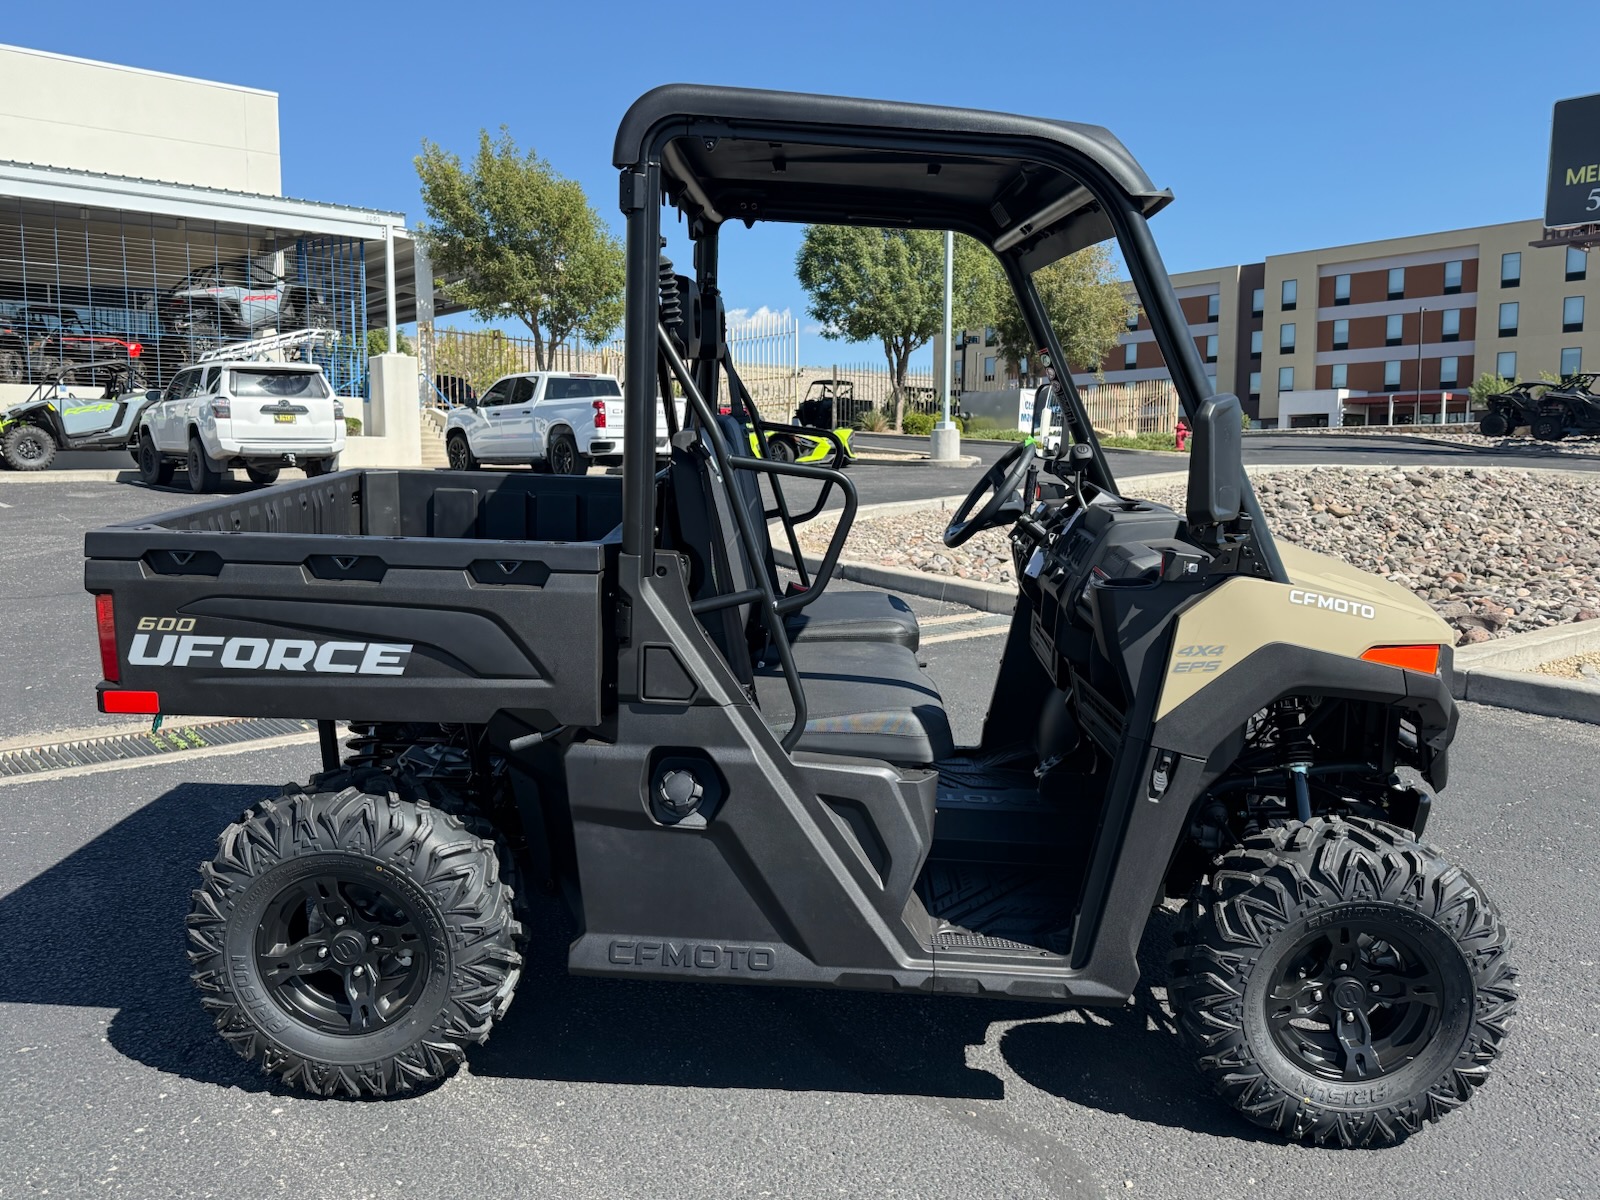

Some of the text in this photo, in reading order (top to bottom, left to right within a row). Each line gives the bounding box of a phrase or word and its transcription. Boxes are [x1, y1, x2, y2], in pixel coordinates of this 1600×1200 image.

[64, 403, 113, 416] RZR
[1289, 589, 1375, 619] CFMOTO
[136, 616, 197, 632] 600
[127, 634, 414, 676] UFORCE
[1177, 644, 1226, 657] 4X4
[1172, 660, 1222, 674] EPS
[608, 940, 776, 972] CFMOTO
[231, 955, 290, 1036] ARISUN
[1295, 1077, 1391, 1106] ARISUN
